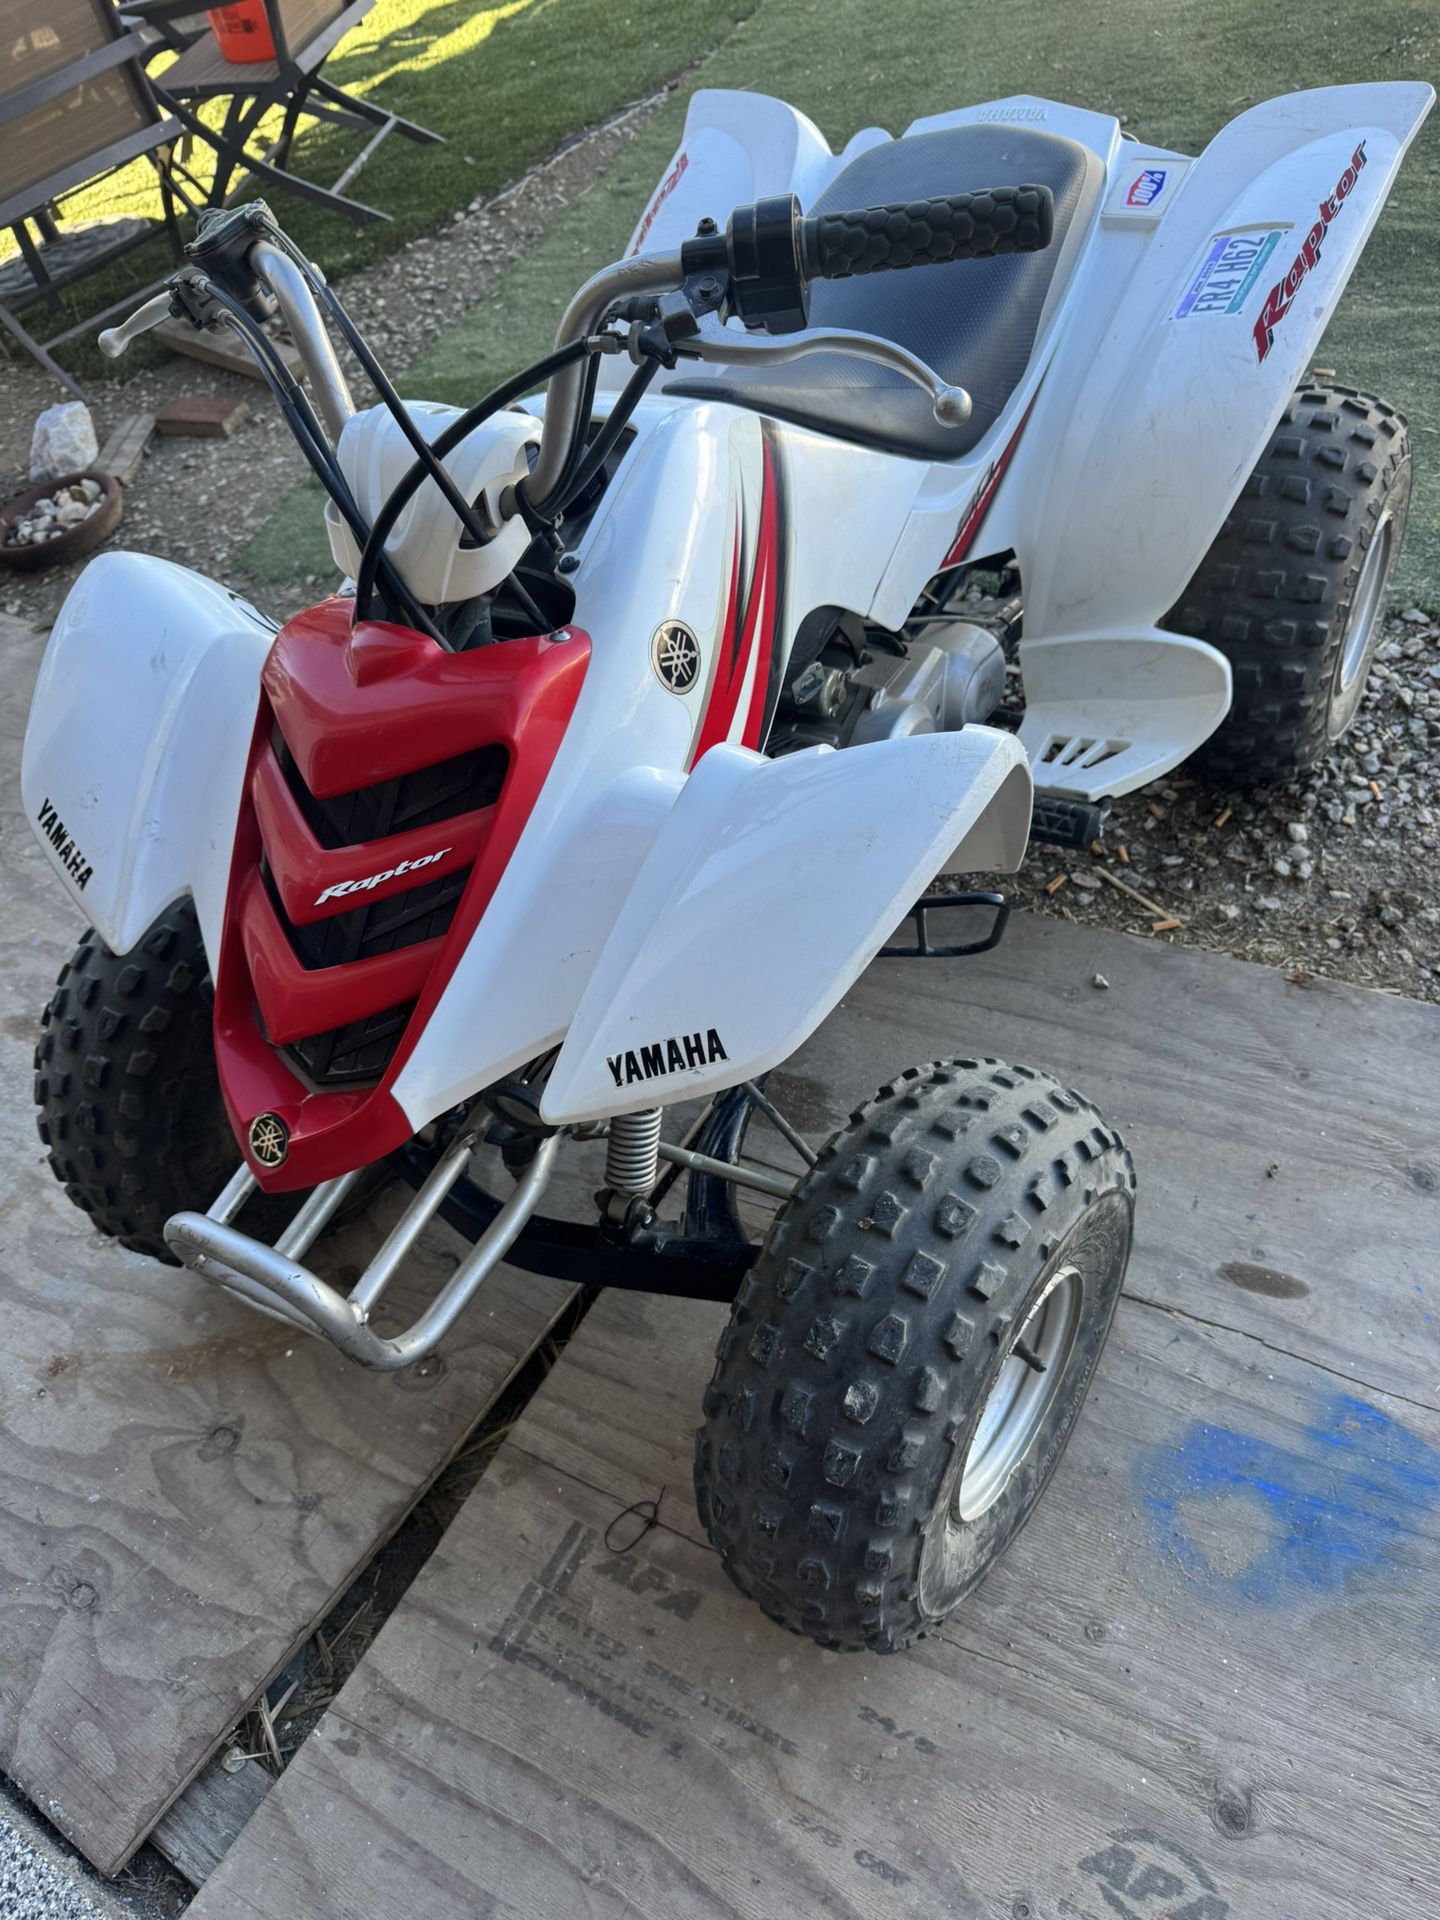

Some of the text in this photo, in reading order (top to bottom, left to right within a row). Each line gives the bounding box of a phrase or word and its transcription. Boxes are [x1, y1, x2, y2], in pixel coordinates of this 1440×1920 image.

[1131, 172, 1164, 203] 100%
[1213, 236, 1266, 274] H62
[1253, 139, 1367, 366] Raptor
[1191, 279, 1241, 313] FR4
[37, 796, 93, 892] YAMAHA
[313, 847, 453, 906] Raptor
[605, 1027, 729, 1088] YAMAHA
